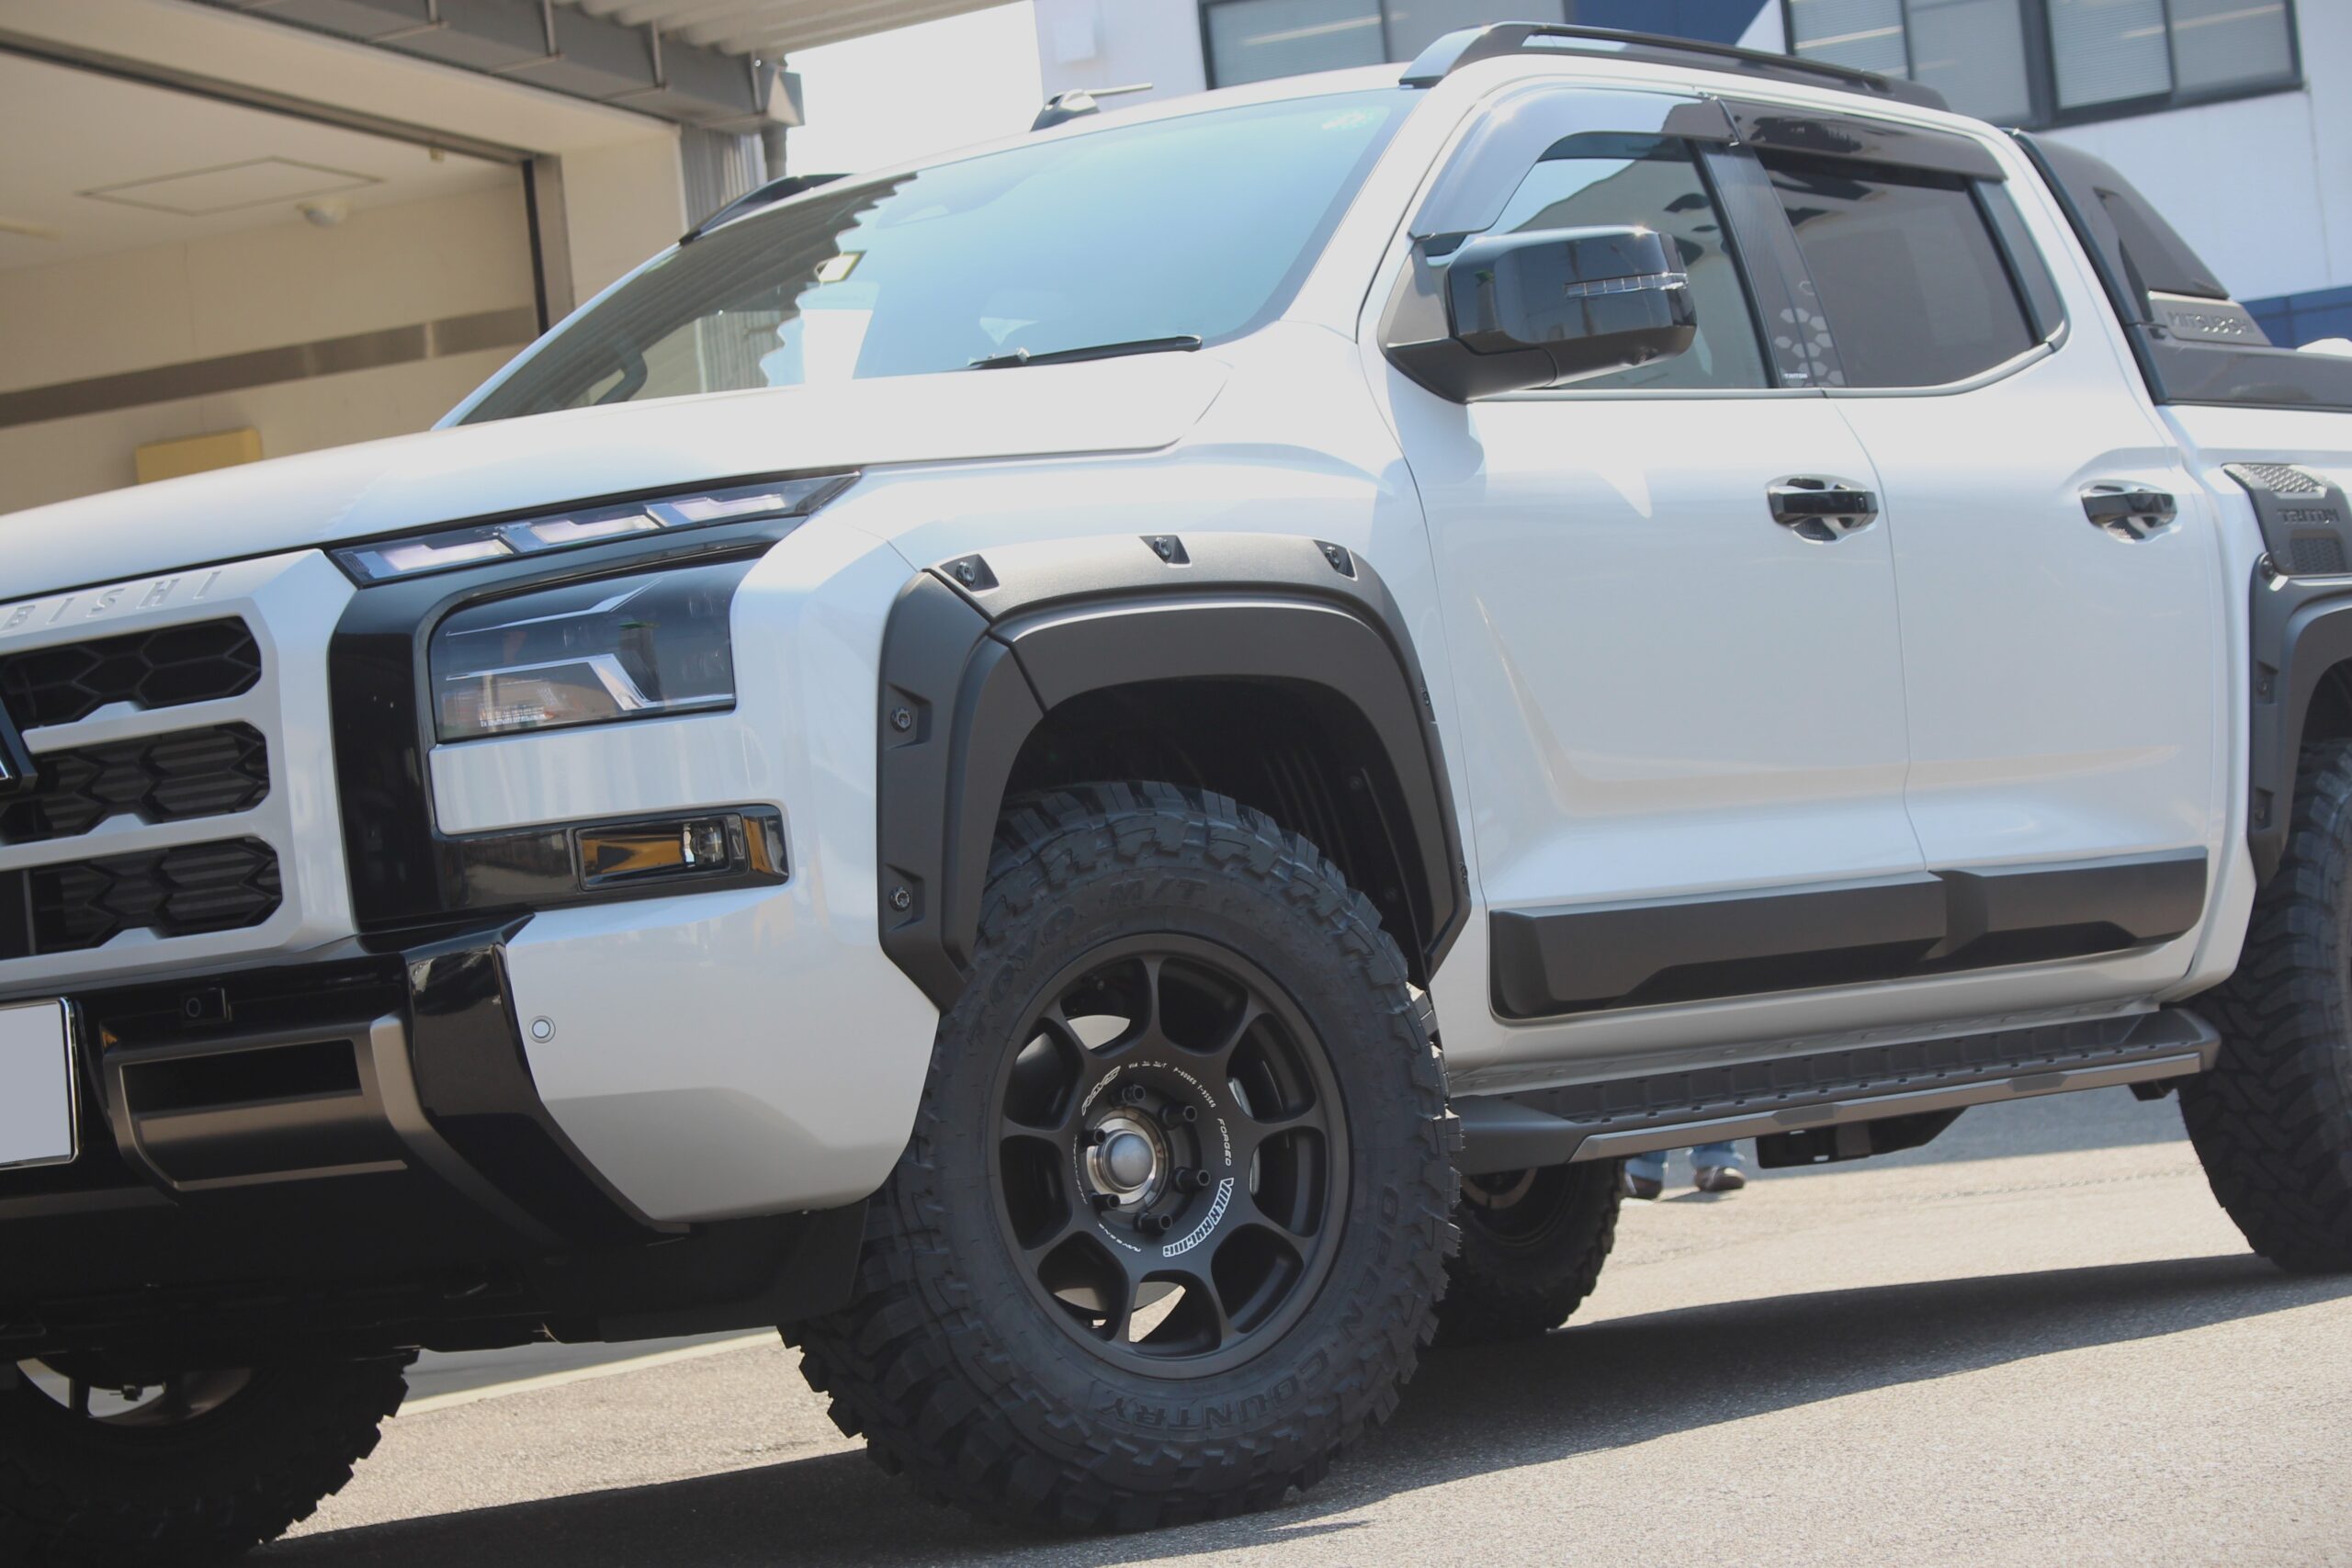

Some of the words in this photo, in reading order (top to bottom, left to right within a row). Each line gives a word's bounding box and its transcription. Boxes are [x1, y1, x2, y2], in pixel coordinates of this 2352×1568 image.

[2277, 508, 2341, 524] TRITON
[1108, 874, 1209, 908] M/T
[1216, 1118, 1232, 1167] FORGED
[1162, 1216, 1215, 1258] RACING
[1338, 1186, 1399, 1341] OPEN
[1101, 1348, 1329, 1429] COUNTRY
